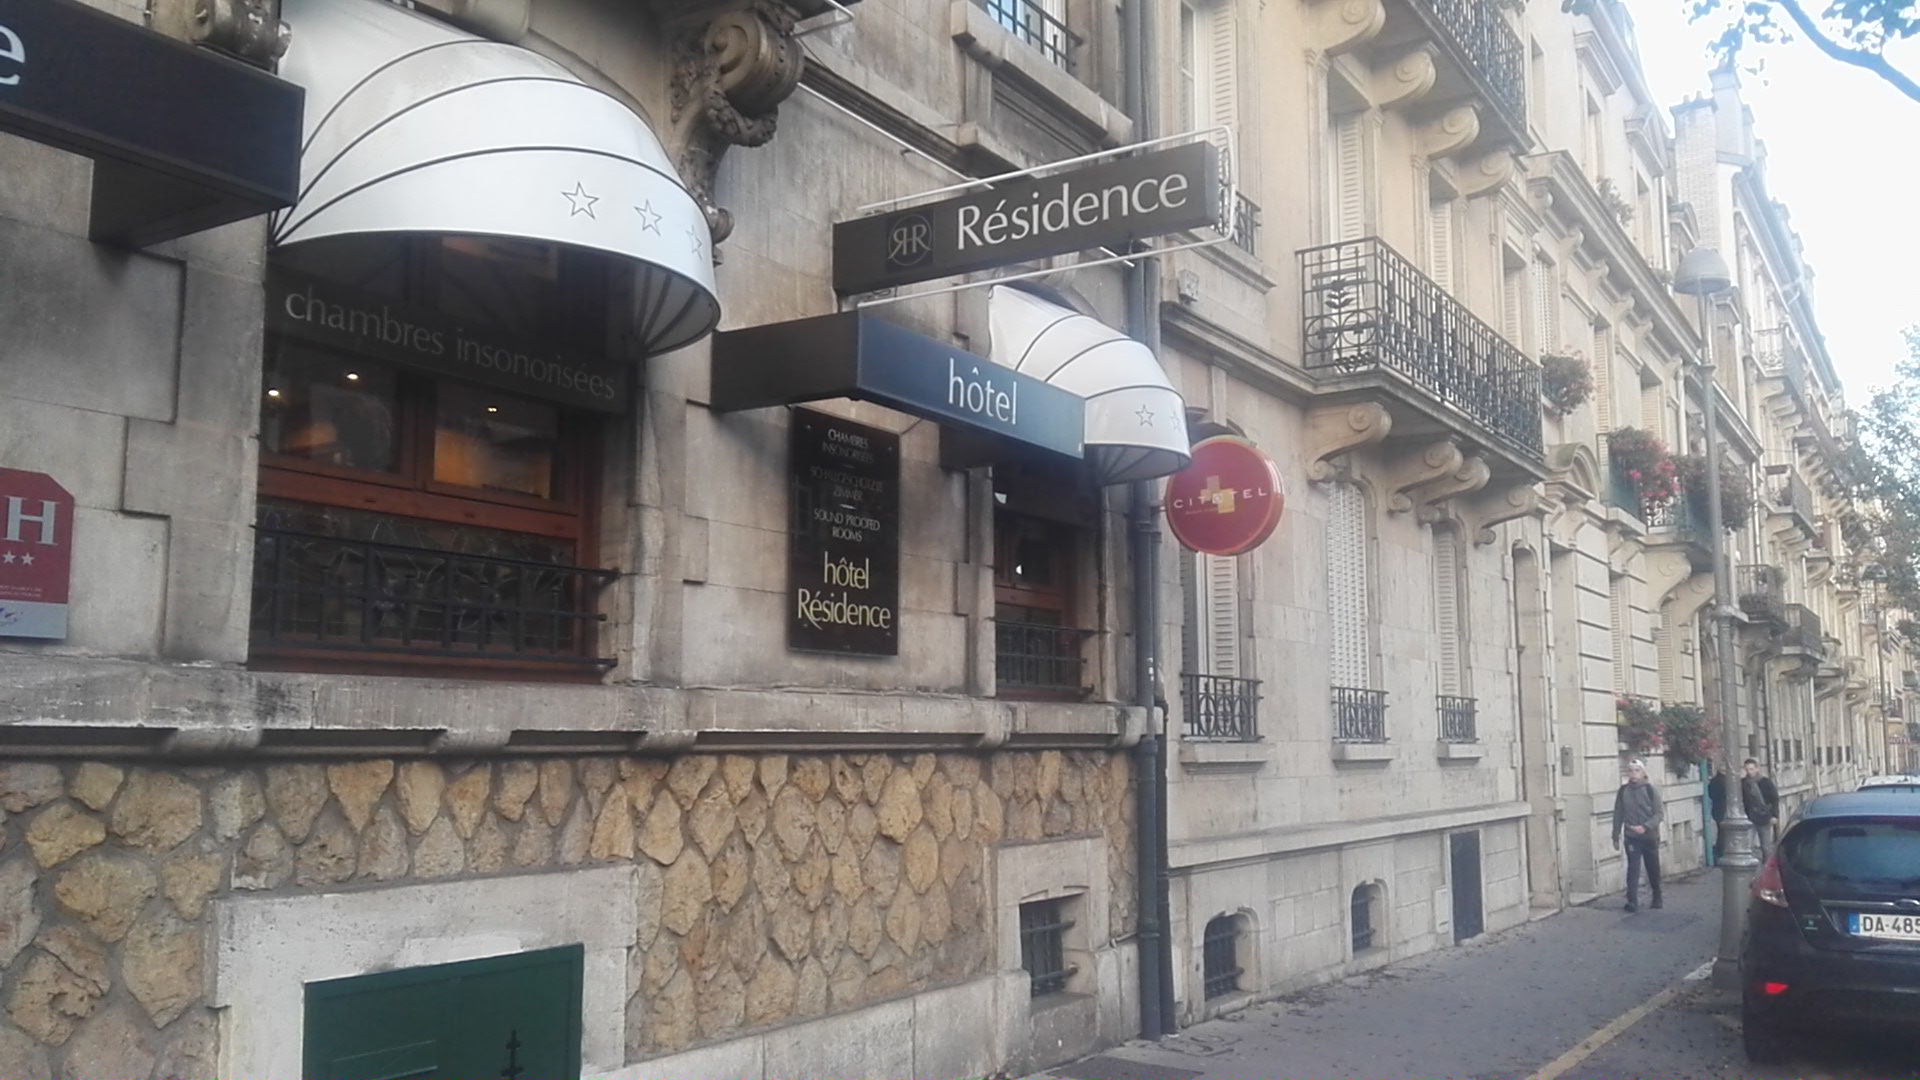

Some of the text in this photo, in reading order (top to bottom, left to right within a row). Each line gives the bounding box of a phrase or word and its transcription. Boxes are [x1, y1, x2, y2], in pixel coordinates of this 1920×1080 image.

[957, 172, 1188, 251] Résidence
[285, 283, 616, 401] chambres insonorisées
[948, 357, 1018, 425] hôtel
[827, 428, 869, 449] CHAMBRES
[1173, 487, 1268, 509] CITOTEL
[1, 495, 60, 546] H
[813, 507, 881, 532] SOUND PROOFED
[832, 526, 863, 543] ROOMS
[824, 551, 869, 590] hôtel
[798, 588, 891, 630] Résidence
